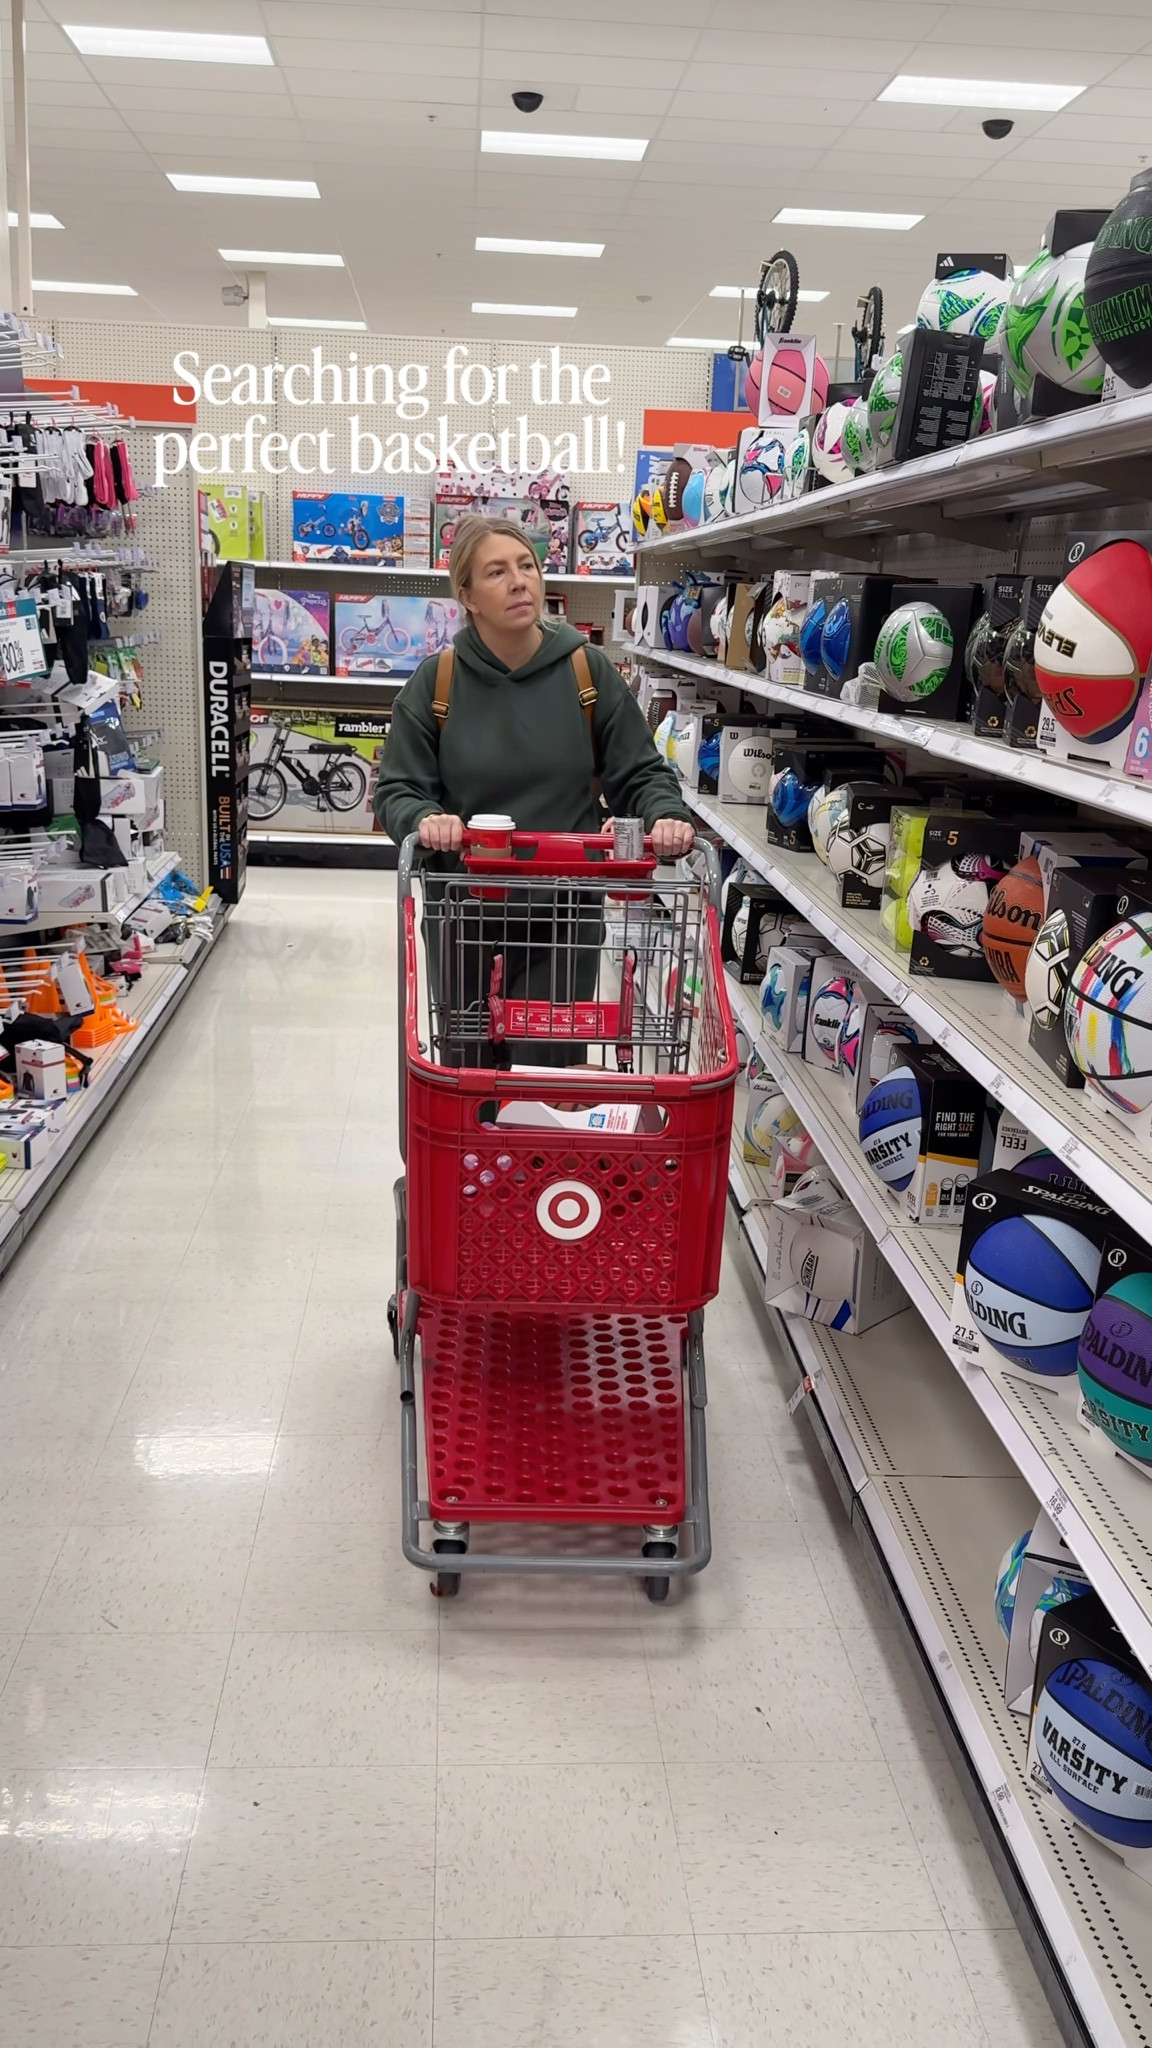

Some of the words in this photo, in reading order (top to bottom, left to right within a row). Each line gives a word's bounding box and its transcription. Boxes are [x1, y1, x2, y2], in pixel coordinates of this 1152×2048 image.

[440, 496, 470, 504] HUFFY
[1036, 584, 1053, 592] SIZE
[209, 661, 230, 777] DURACELL
[338, 722, 385, 733] rambler
[1134, 726, 1150, 757] 6
[218, 796, 231, 832] BUILT
[789, 831, 797, 844] 5
[947, 831, 959, 846] 5
[219, 843, 231, 868] USA
[935, 1111, 957, 1123] FIND
[958, 1112, 976, 1123] THE
[934, 1122, 957, 1132] RIGHT
[957, 1123, 974, 1132] SIZE
[1000, 1135, 1027, 1151] FEEL
[1022, 1185, 1113, 1216] SPALDING
[1050, 1495, 1064, 1516] 16.99
[1042, 1715, 1128, 1796] VARSITY
[1049, 1751, 1062, 1766] ALL
[1062, 1763, 1100, 1795] SURFACE
